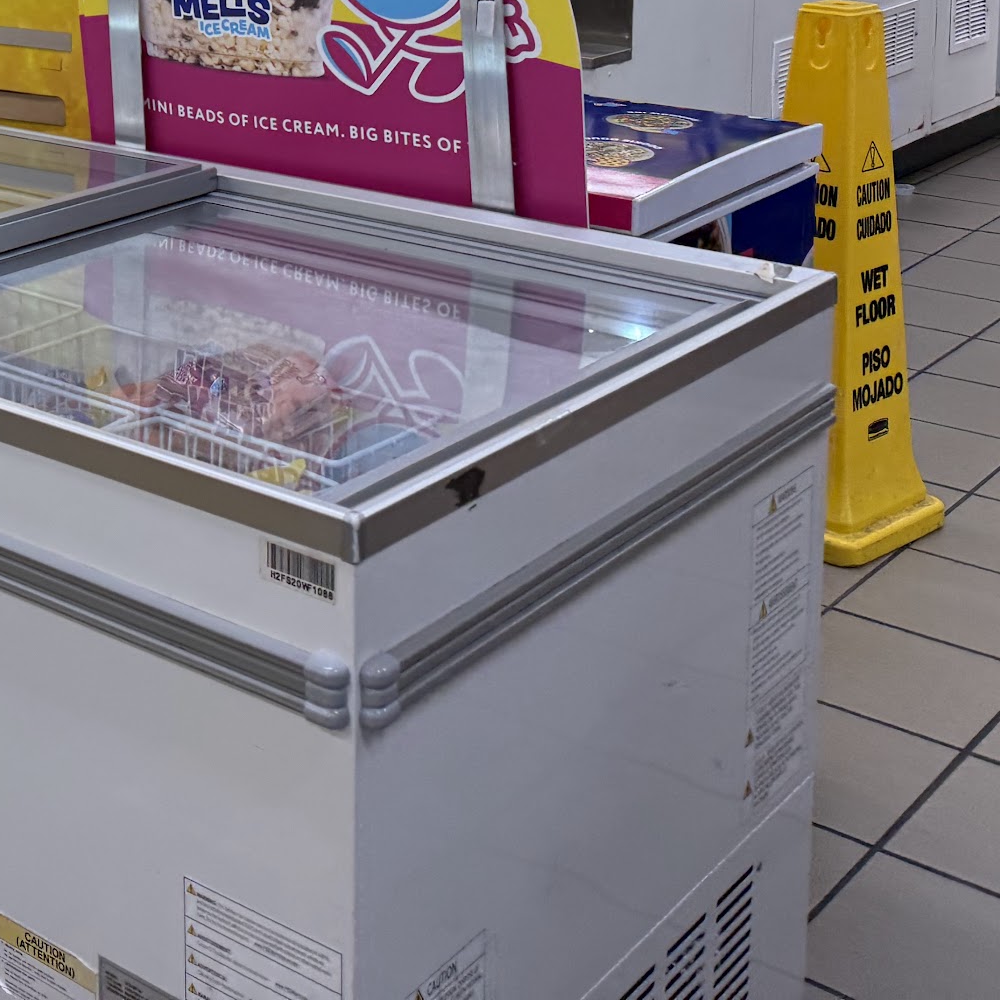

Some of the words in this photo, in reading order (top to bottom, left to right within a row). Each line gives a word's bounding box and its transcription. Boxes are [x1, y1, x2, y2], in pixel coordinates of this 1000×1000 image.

[200, 20, 222, 36] ICE
[221, 19, 271, 41] CREAM
[177, 104, 225, 124] BEADS
[228, 111, 249, 127] OF
[253, 115, 278, 132] ICE
[282, 119, 345, 139] CREAM.
[349, 126, 378, 142] BIG
[383, 129, 432, 150] BITES
[437, 137, 462, 154] OF
[856, 176, 891, 208] CAUTION
[856, 209, 892, 242] CUIDADO
[860, 264, 889, 294] WET
[855, 293, 896, 328] FLOOR
[862, 344, 891, 376] PISO
[852, 371, 904, 413] MOJADO
[16, 936, 75, 980] (ATTENTION)
[23, 931, 66, 963] CAUTION
